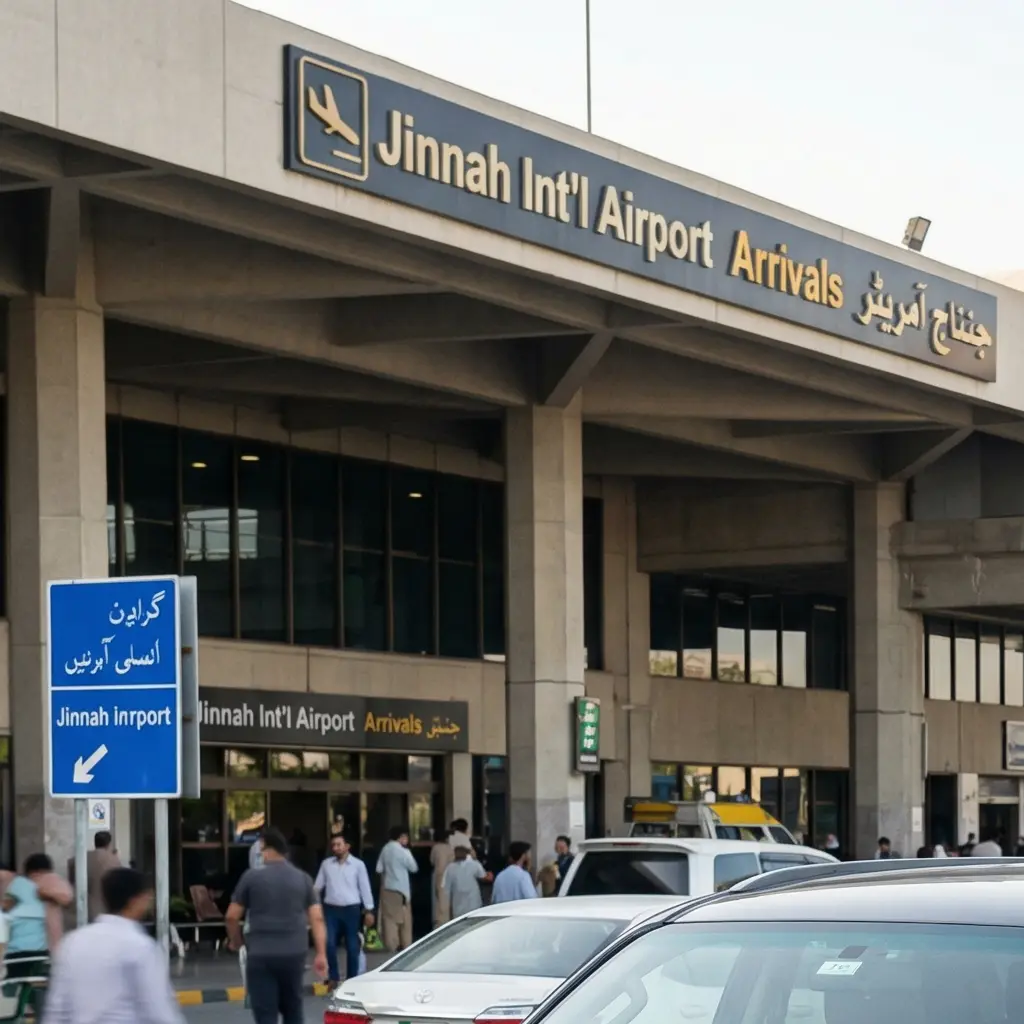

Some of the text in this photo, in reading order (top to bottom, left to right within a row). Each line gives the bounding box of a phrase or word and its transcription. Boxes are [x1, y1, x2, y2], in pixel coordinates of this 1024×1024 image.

[375, 109, 844, 310] Jinnah Int'l Airport Arrivals
[56, 705, 109, 727] Jinnah
[259, 703, 292, 729] Int'l
[296, 706, 355, 736] Airport
[364, 711, 422, 735] Arrivals
